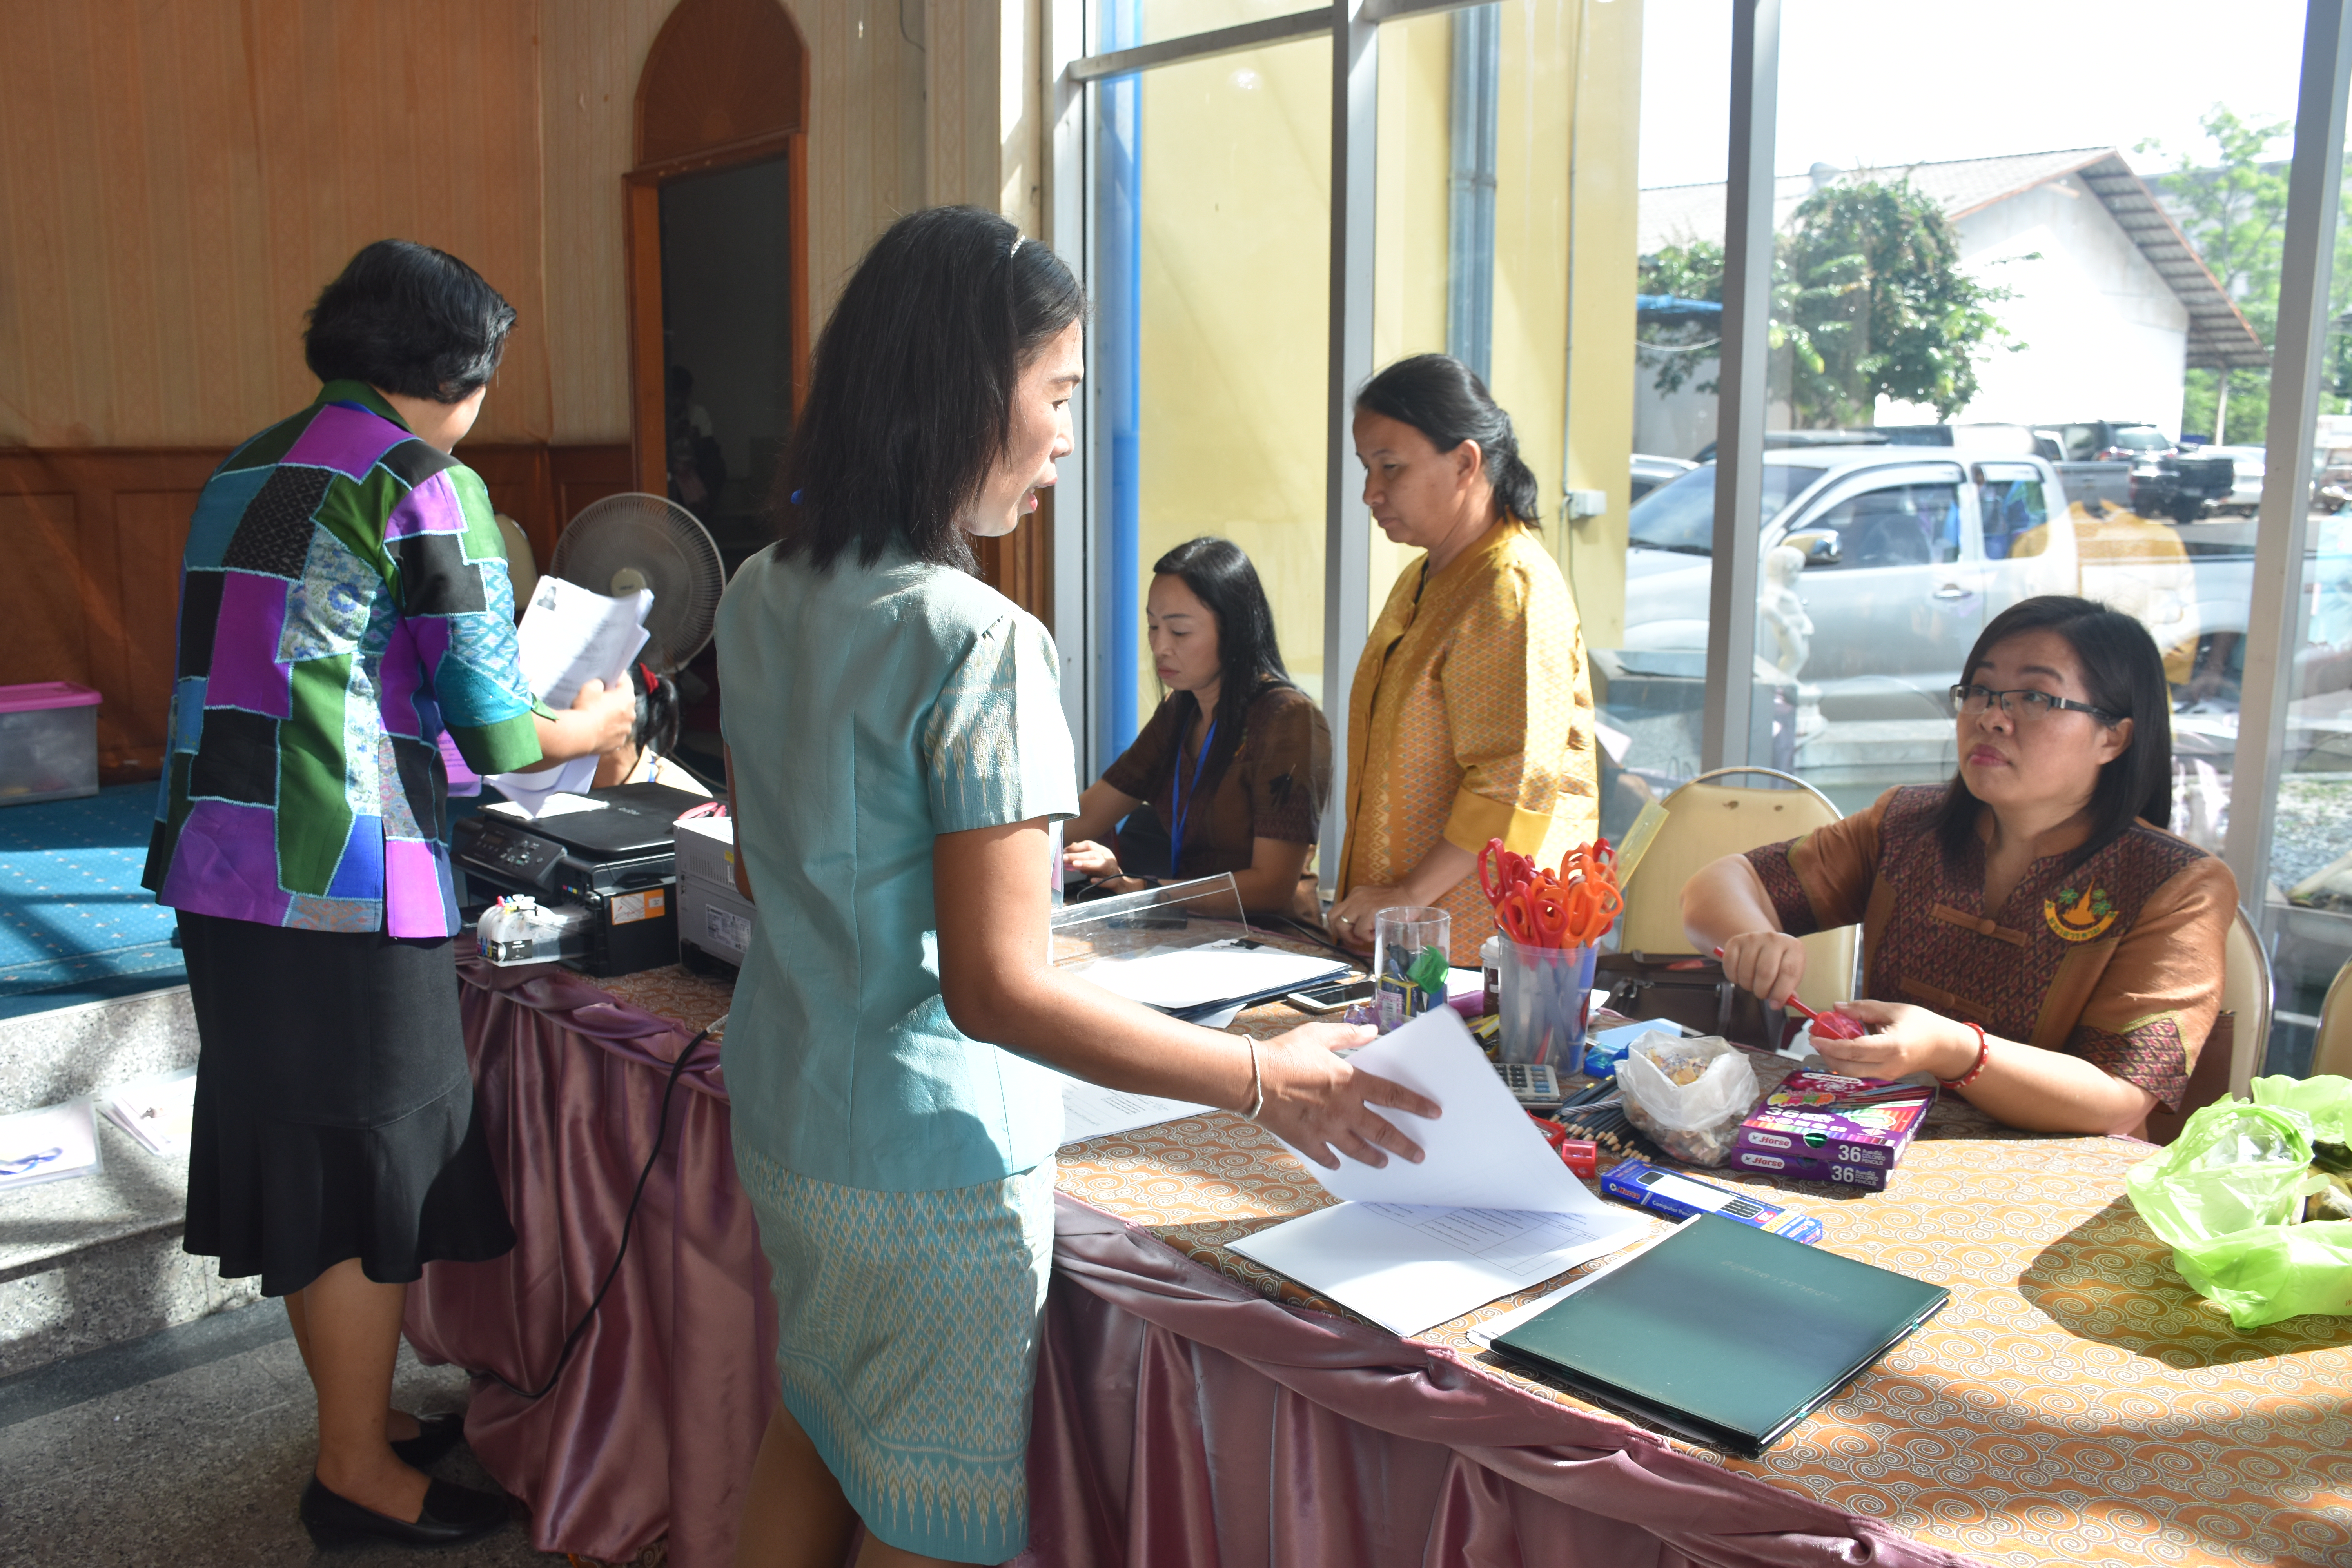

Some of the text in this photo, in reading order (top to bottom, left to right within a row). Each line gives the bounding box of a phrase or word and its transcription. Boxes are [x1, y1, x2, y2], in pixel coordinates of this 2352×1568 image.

[1765, 1107, 1801, 1118] 36
[1759, 1136, 1789, 1147] Horse
[1838, 1144, 1861, 1162] 36
[1752, 1157, 1783, 1168] Horse
[1831, 1165, 1854, 1183] 36
[1617, 1187, 1641, 1200] Horse
[1652, 1200, 1678, 1213] Computer
[1757, 1212, 1774, 1221] 2B
[1765, 1214, 1791, 1230] H-9100
[1787, 1223, 1808, 1238] Horse
